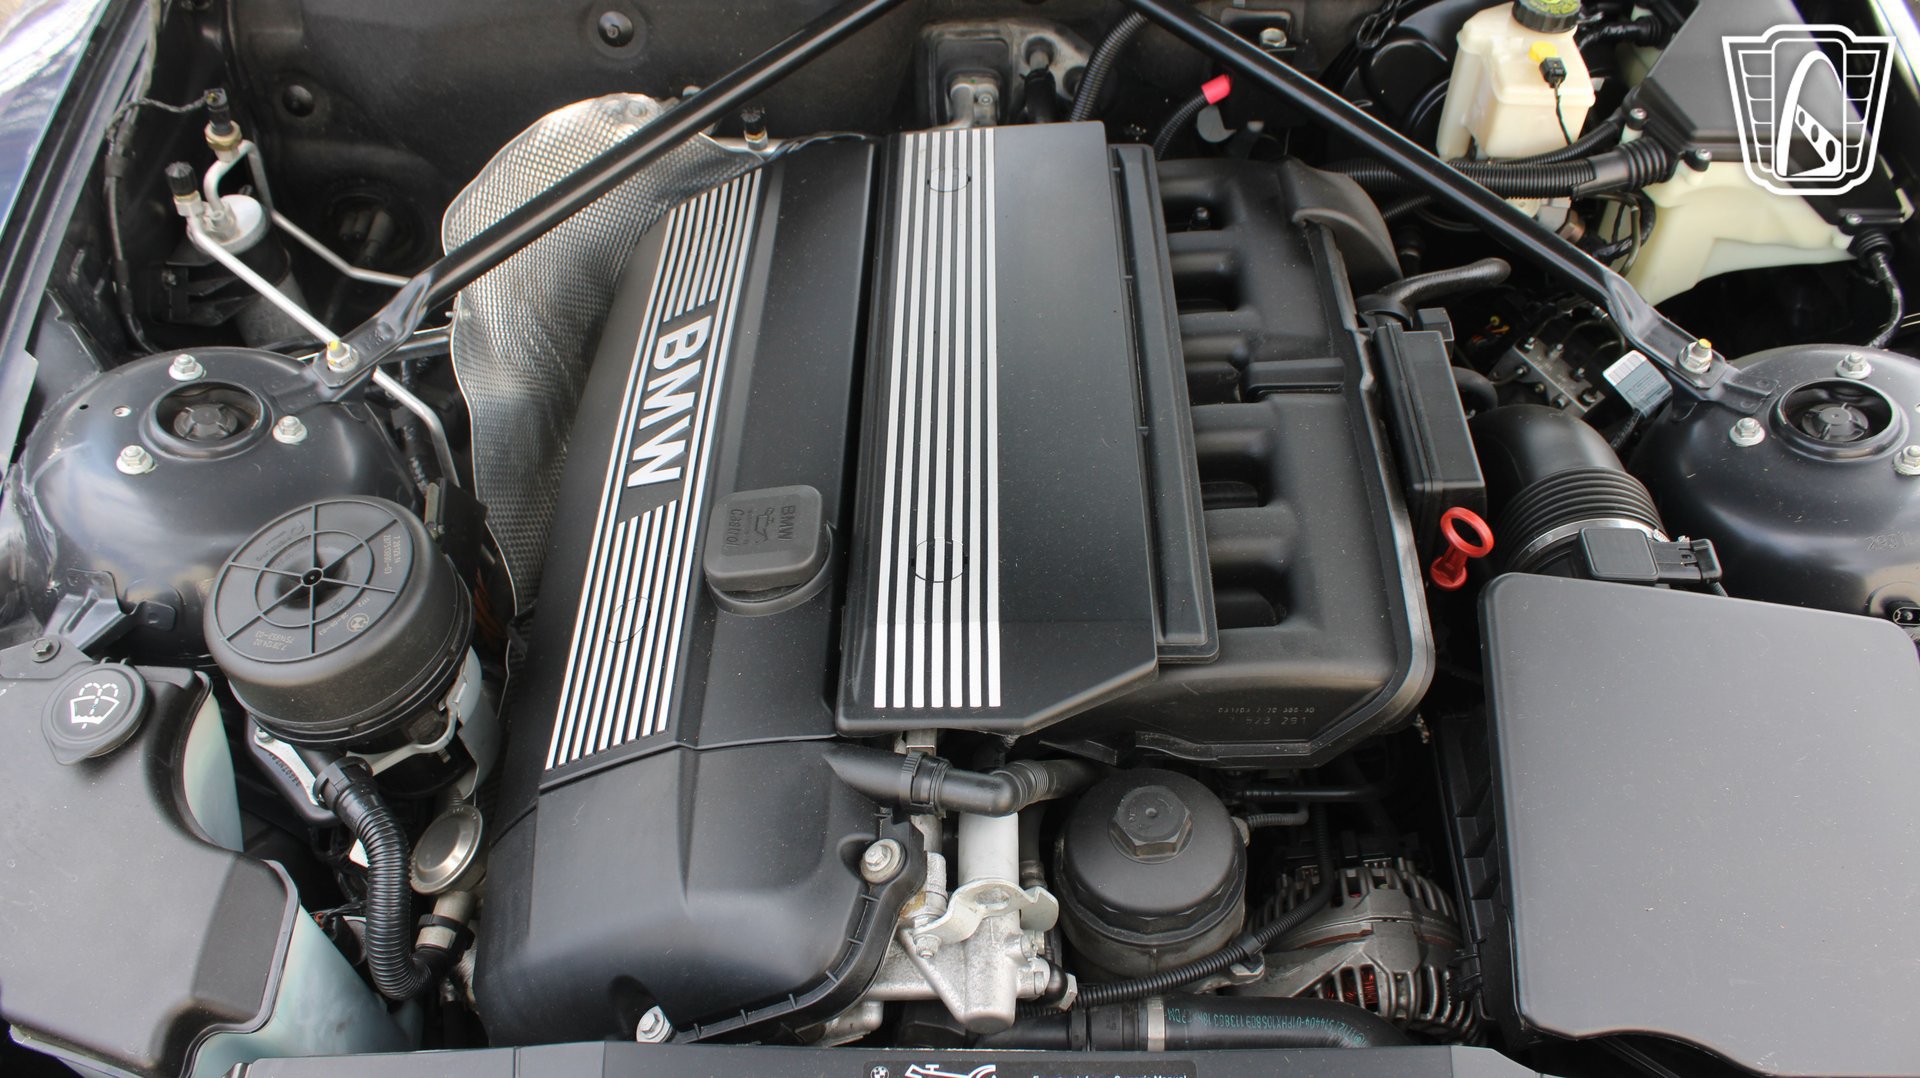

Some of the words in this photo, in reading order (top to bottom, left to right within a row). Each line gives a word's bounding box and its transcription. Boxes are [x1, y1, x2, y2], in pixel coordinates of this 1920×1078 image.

[627, 315, 713, 488] BMW
[724, 508, 744, 547] Castrol
[778, 504, 796, 541] BMW
